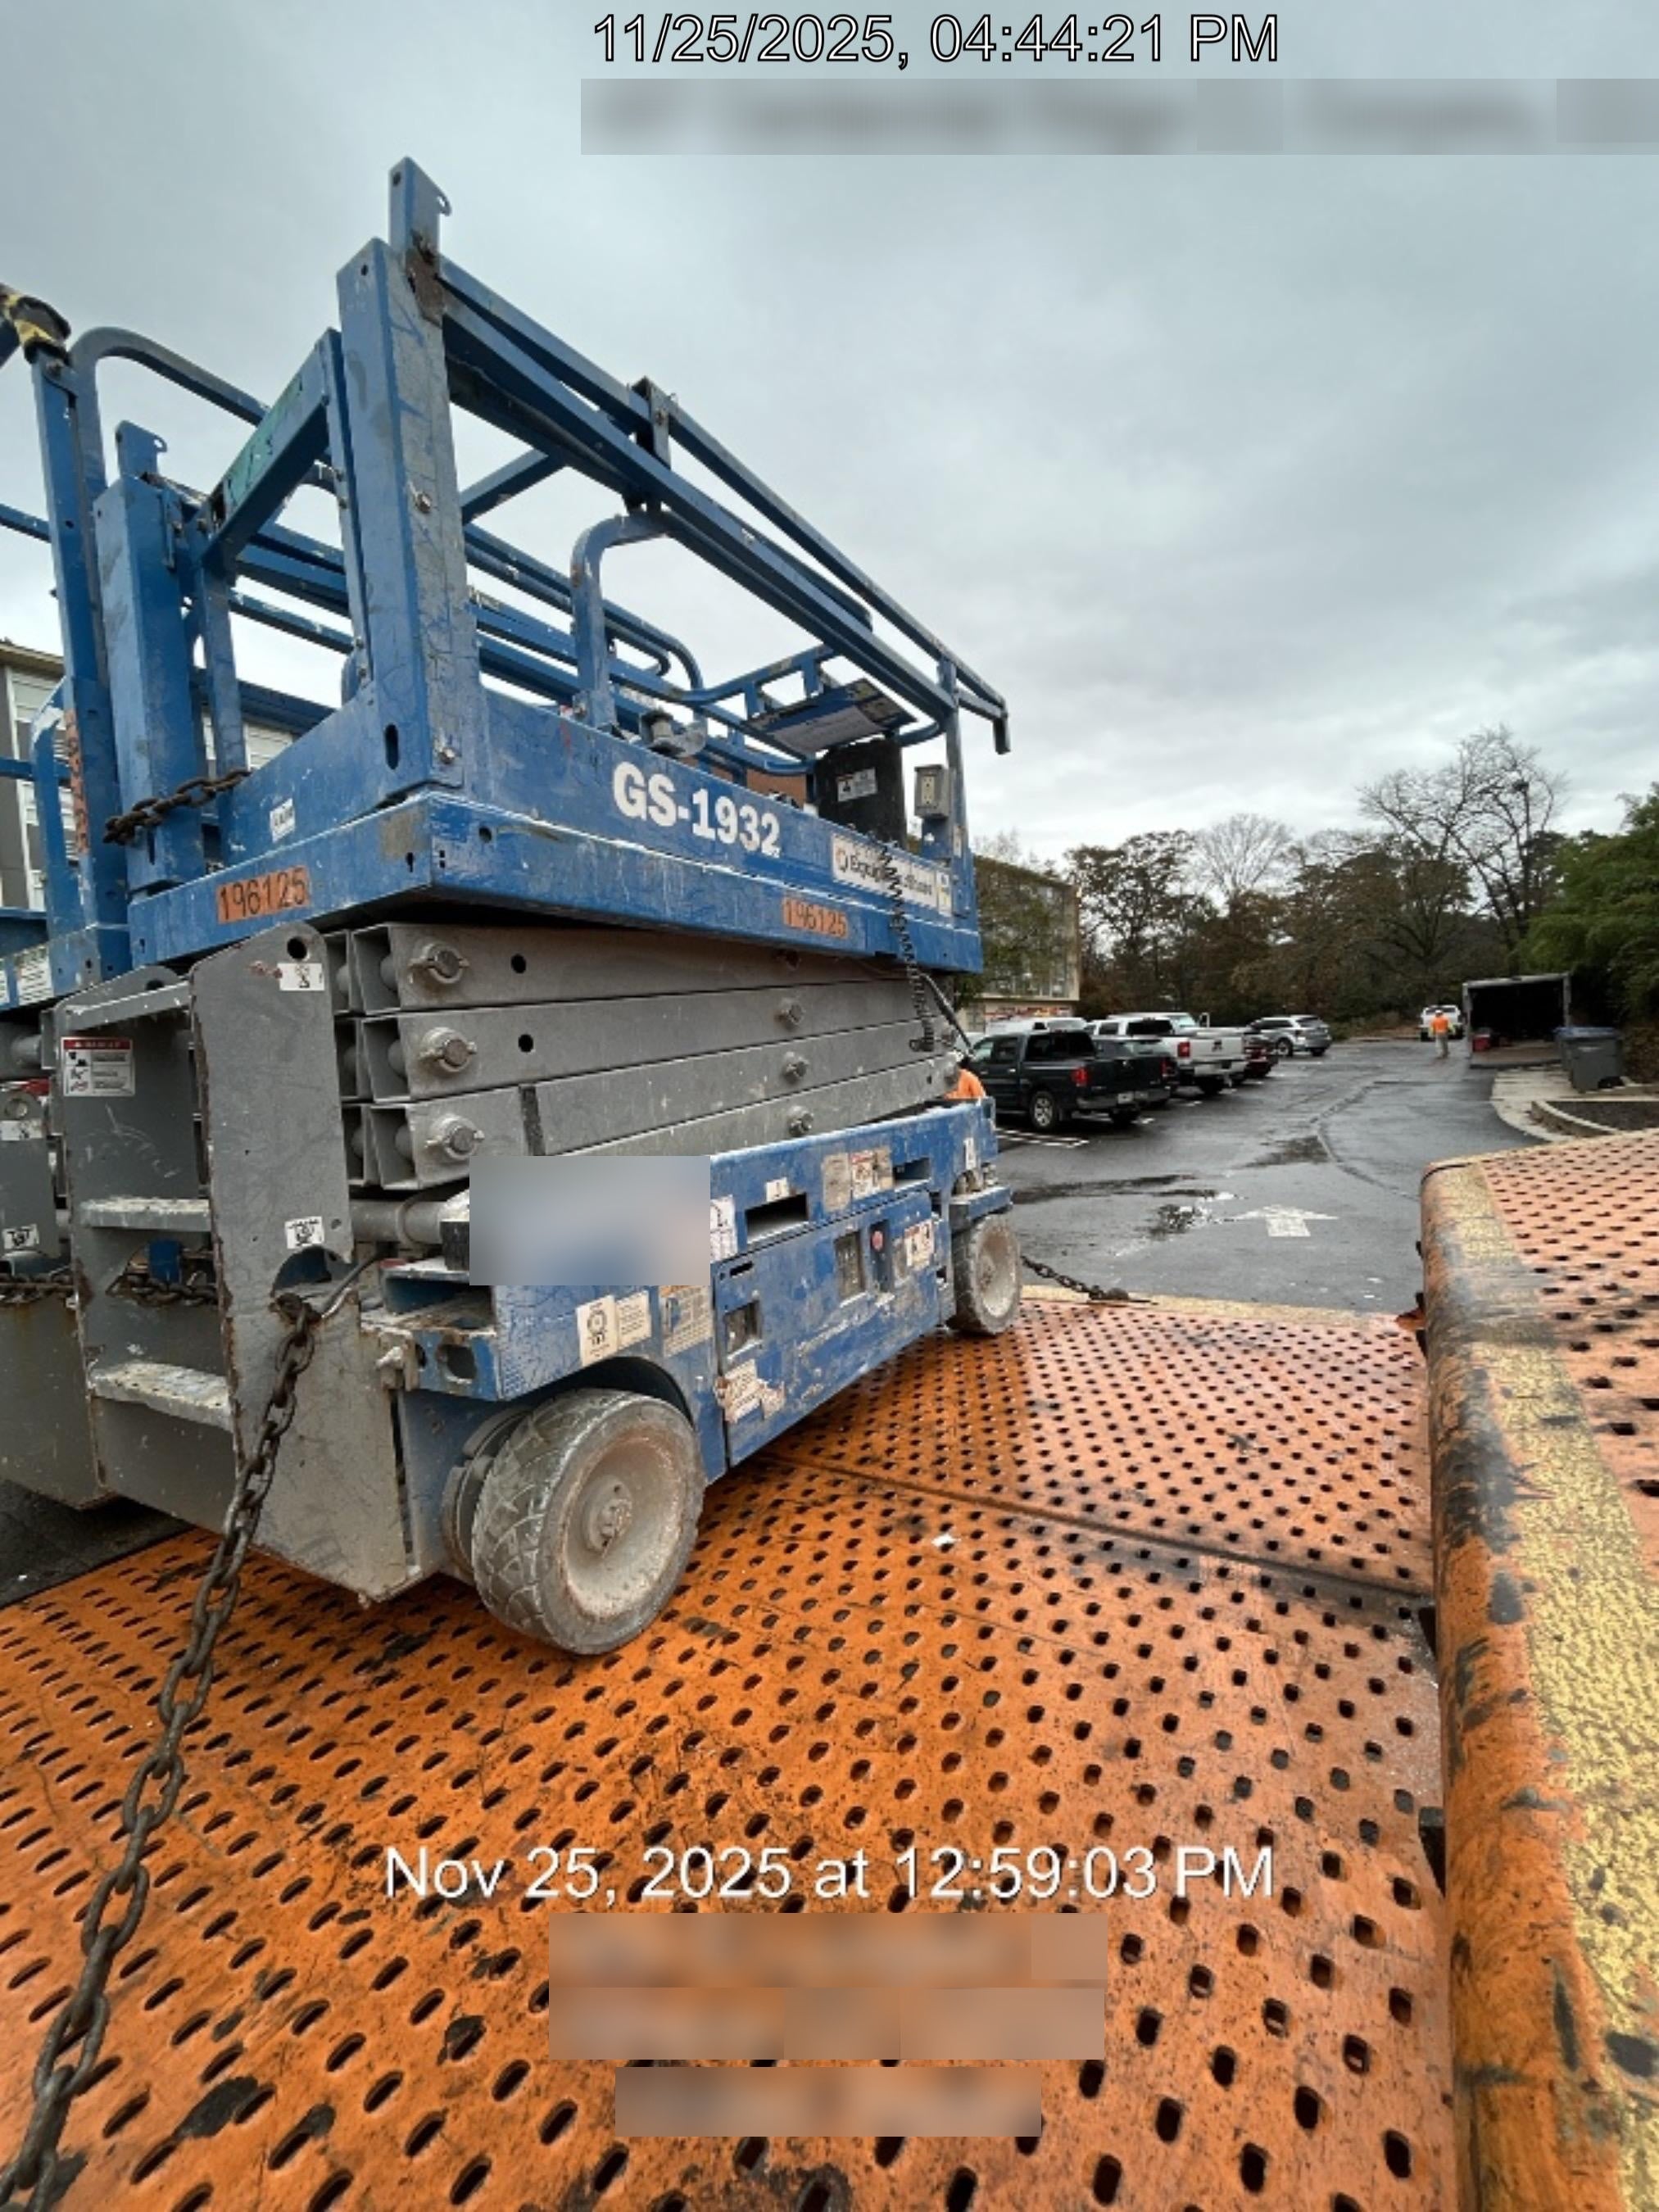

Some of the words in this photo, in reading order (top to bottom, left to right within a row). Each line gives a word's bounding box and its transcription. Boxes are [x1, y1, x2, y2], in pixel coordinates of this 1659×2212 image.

[614, 762, 781, 858] GS-1932
[220, 866, 306, 920] 196125
[850, 854, 932, 895] EquipShare
[784, 900, 847, 937] 196125
